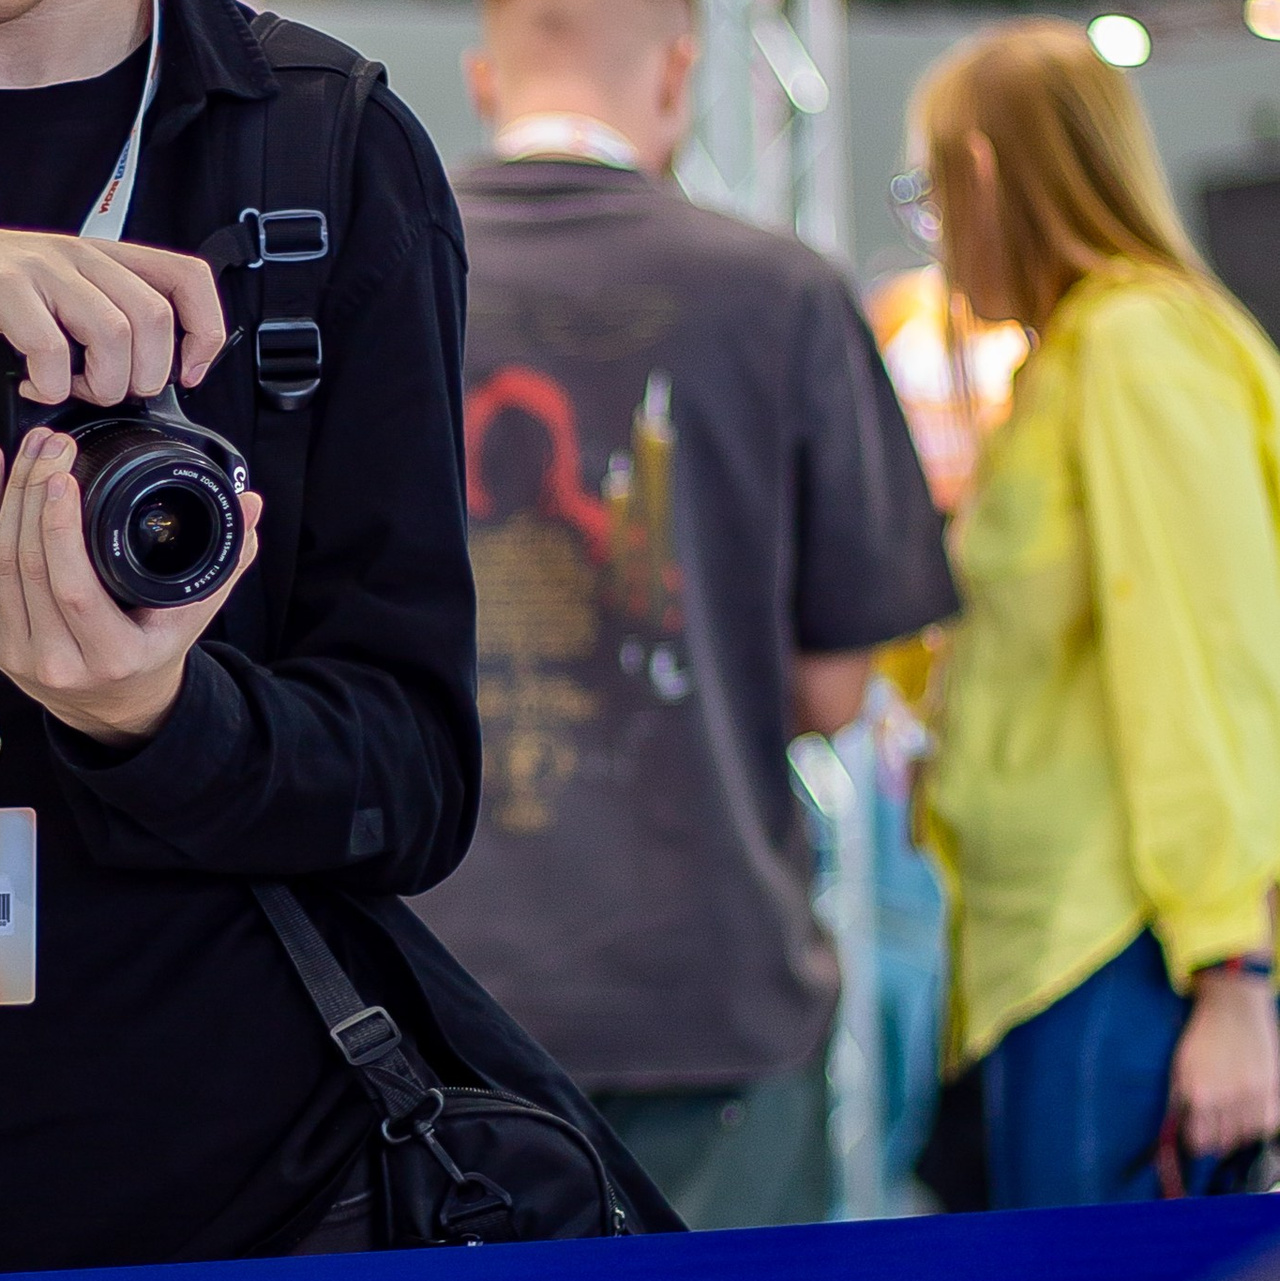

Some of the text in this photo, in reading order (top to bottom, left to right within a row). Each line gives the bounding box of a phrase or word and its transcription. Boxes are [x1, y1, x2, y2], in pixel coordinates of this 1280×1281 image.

[173, 468, 198, 479] CANON
[200, 475, 219, 494] ZOOM
[218, 493, 229, 510] LENS
[233, 466, 246, 494] Ca
